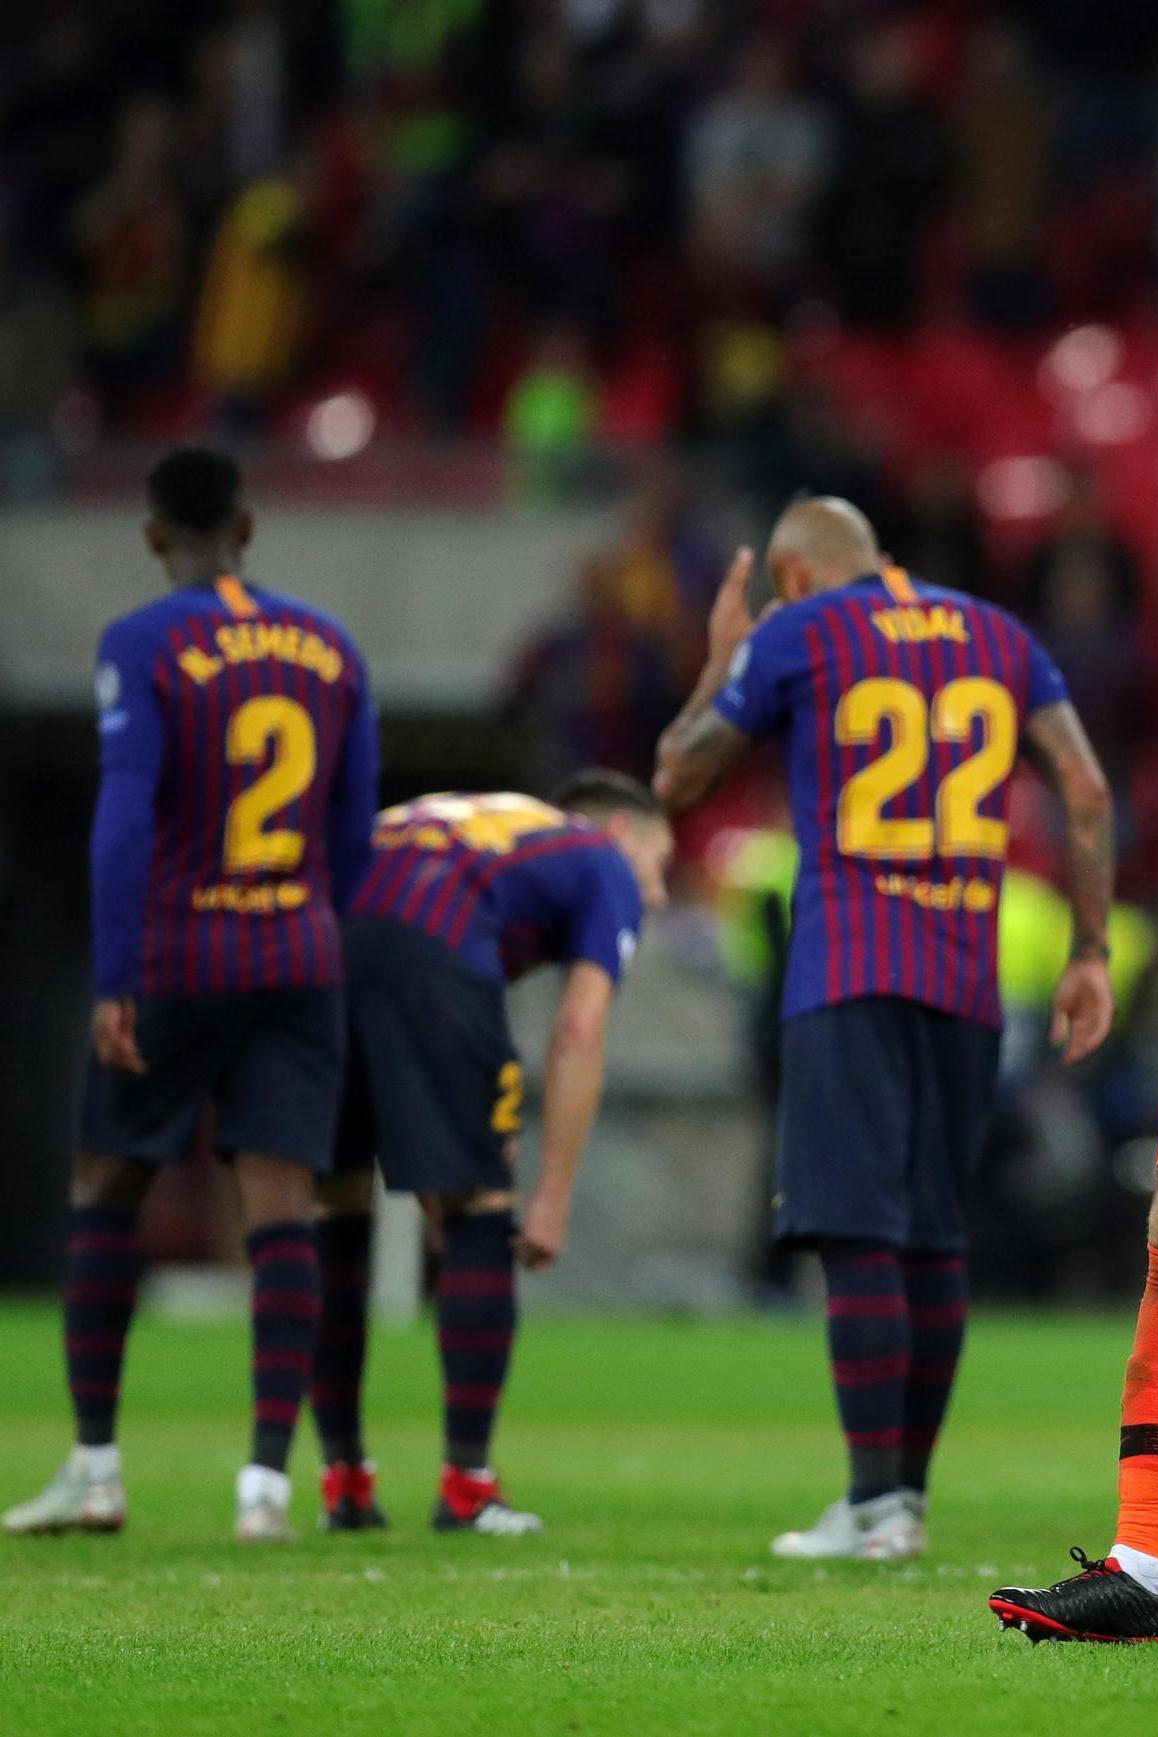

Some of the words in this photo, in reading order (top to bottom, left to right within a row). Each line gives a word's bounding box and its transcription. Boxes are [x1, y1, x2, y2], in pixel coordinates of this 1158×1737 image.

[216, 624, 342, 682] SEMEDO
[873, 608, 968, 642] VIDAL
[226, 696, 315, 872] 2
[837, 677, 1017, 857] 22
[492, 1063, 522, 1132] 2
